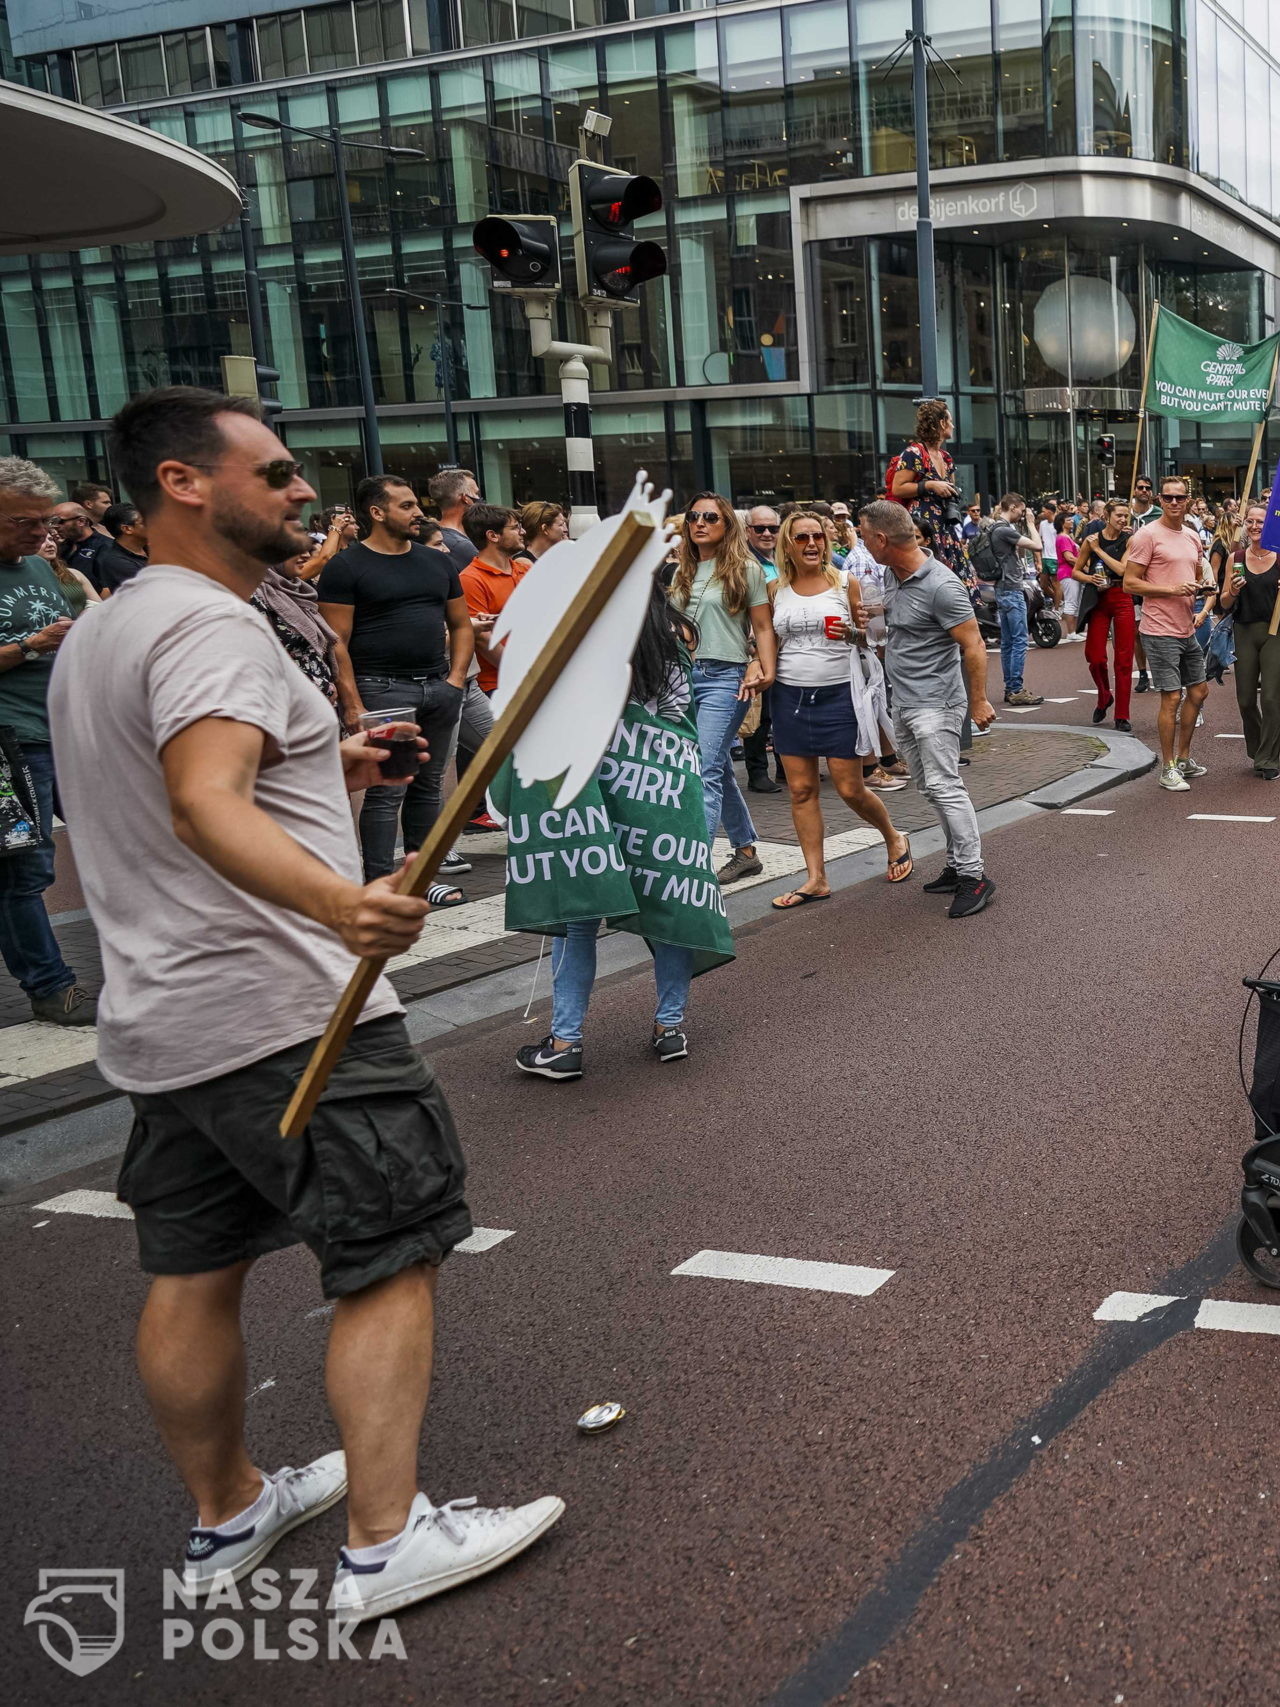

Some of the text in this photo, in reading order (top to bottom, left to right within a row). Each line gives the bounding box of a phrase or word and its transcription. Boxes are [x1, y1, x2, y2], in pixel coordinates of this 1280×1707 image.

[897, 192, 1006, 222] de Bijenkorf
[1200, 360, 1246, 375] CENTRAL
[1155, 380, 1175, 393] YOU
[1175, 386, 1196, 399] CAN
[1198, 391, 1225, 401] MUTE
[1226, 389, 1248, 399] OUR
[1205, 374, 1234, 387] PARK
[1160, 395, 1179, 406] BUT
[1178, 399, 1201, 411] YOU
[1203, 401, 1233, 412] CAN'T
[1233, 401, 1261, 411] MUTE
[600, 755, 686, 809] PARK
[539, 804, 610, 839] CAN
[652, 833, 708, 870] OUR
[505, 851, 555, 885] UT
[560, 843, 626, 878] YOU
